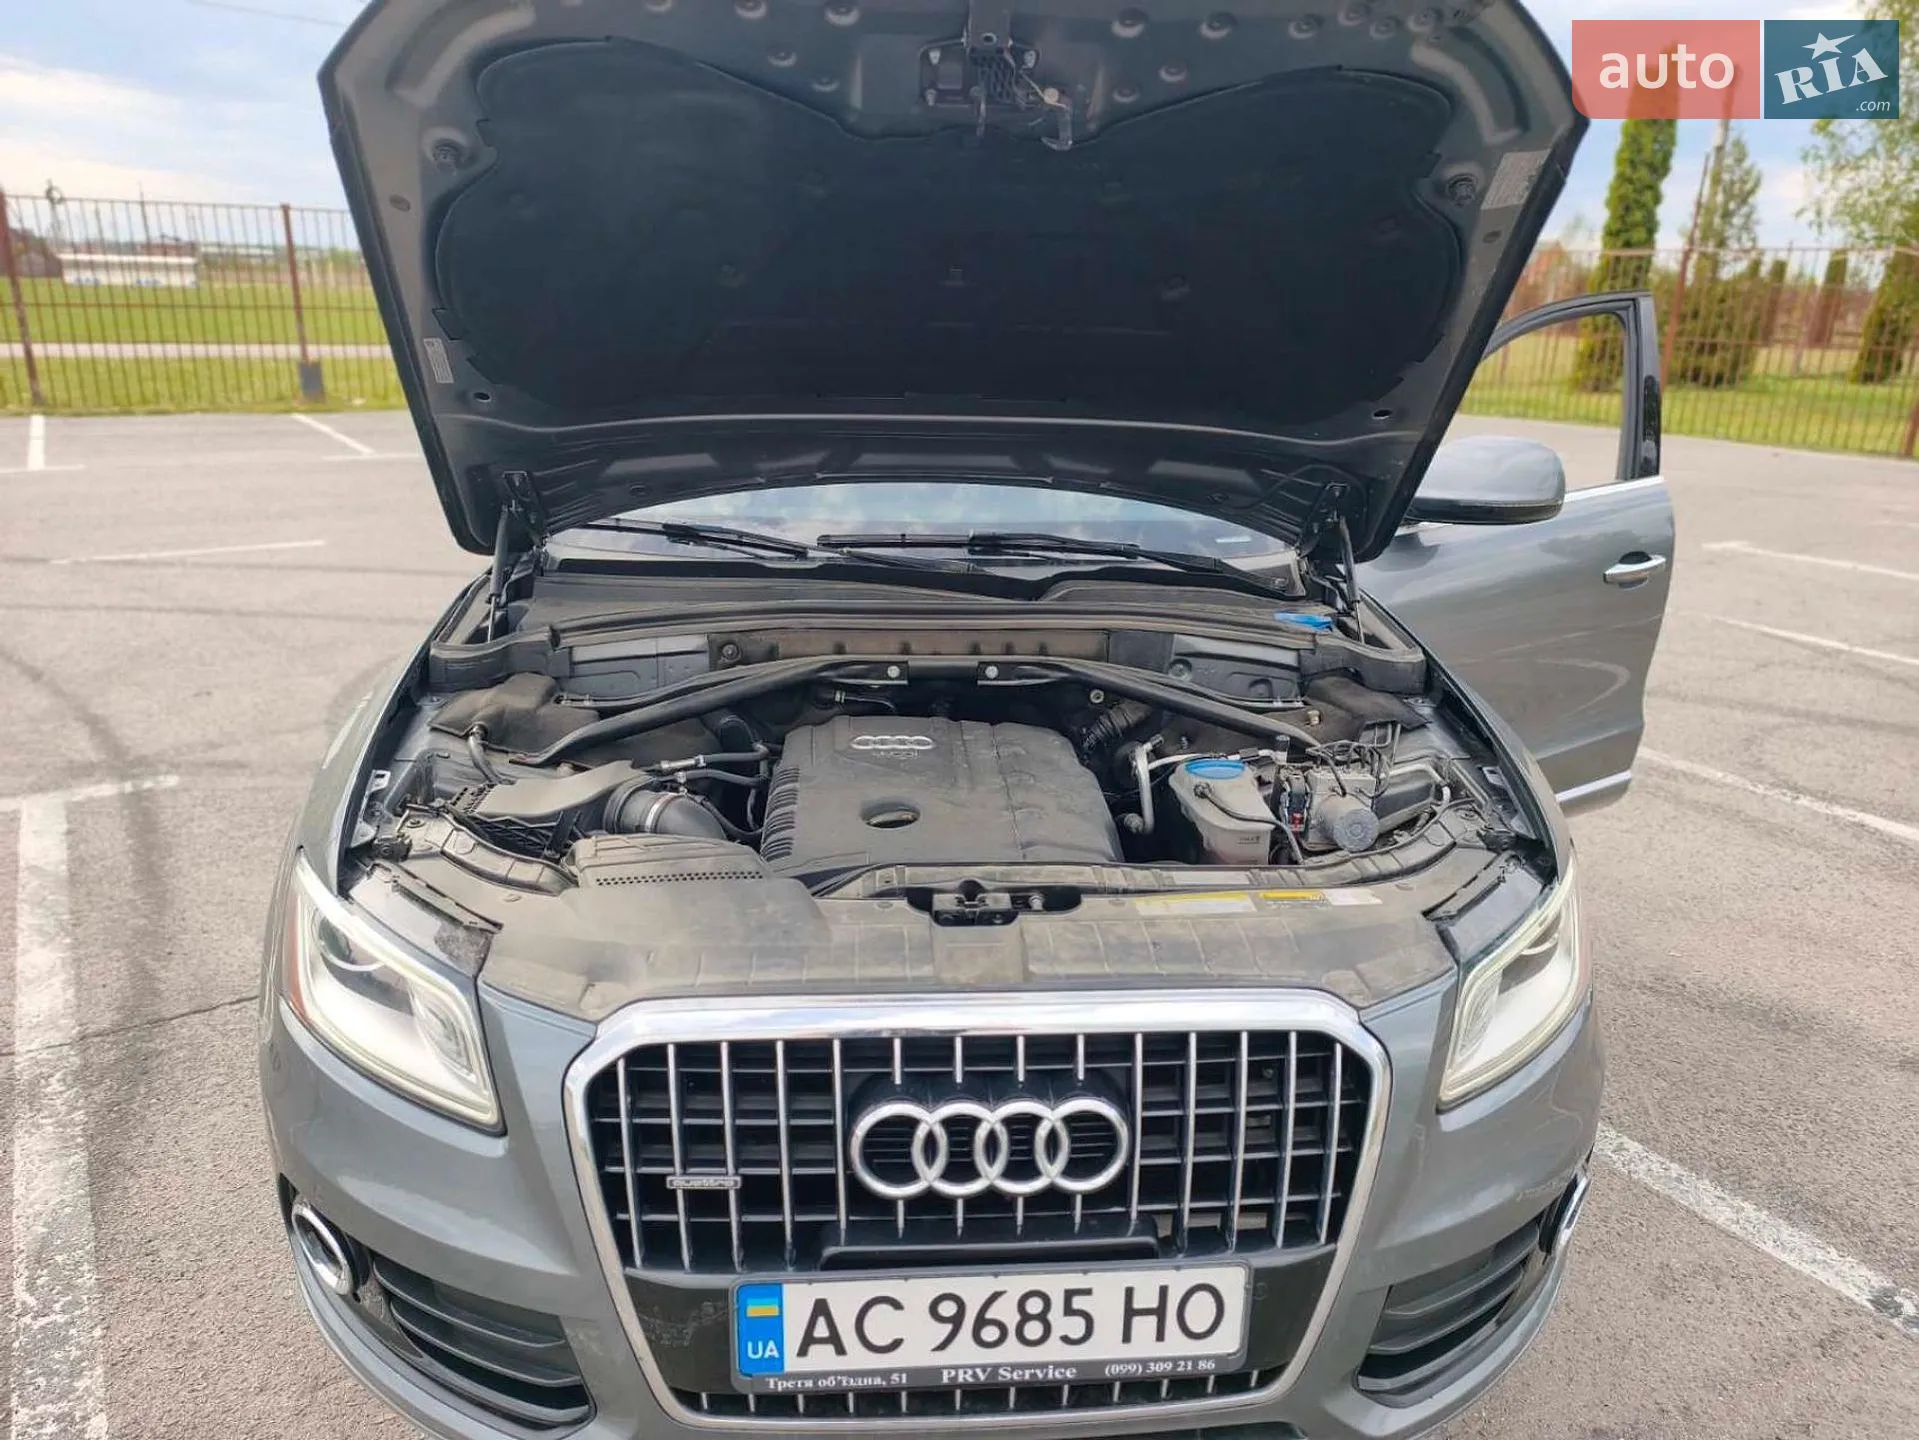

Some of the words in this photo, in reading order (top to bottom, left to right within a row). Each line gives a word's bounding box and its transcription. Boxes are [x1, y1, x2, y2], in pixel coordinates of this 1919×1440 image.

[796, 1295, 905, 1357] AC
[928, 1287, 1095, 1352] 9685
[1121, 1282, 1226, 1344] HO
[746, 1340, 780, 1359] UA
[941, 1367, 991, 1383] PRV
[998, 1364, 1078, 1382] Service
[1104, 1363, 1143, 1377] (099)
[1145, 1361, 1172, 1373] 309
[1176, 1360, 1193, 1371] 21
[890, 1372, 907, 1385] 51
